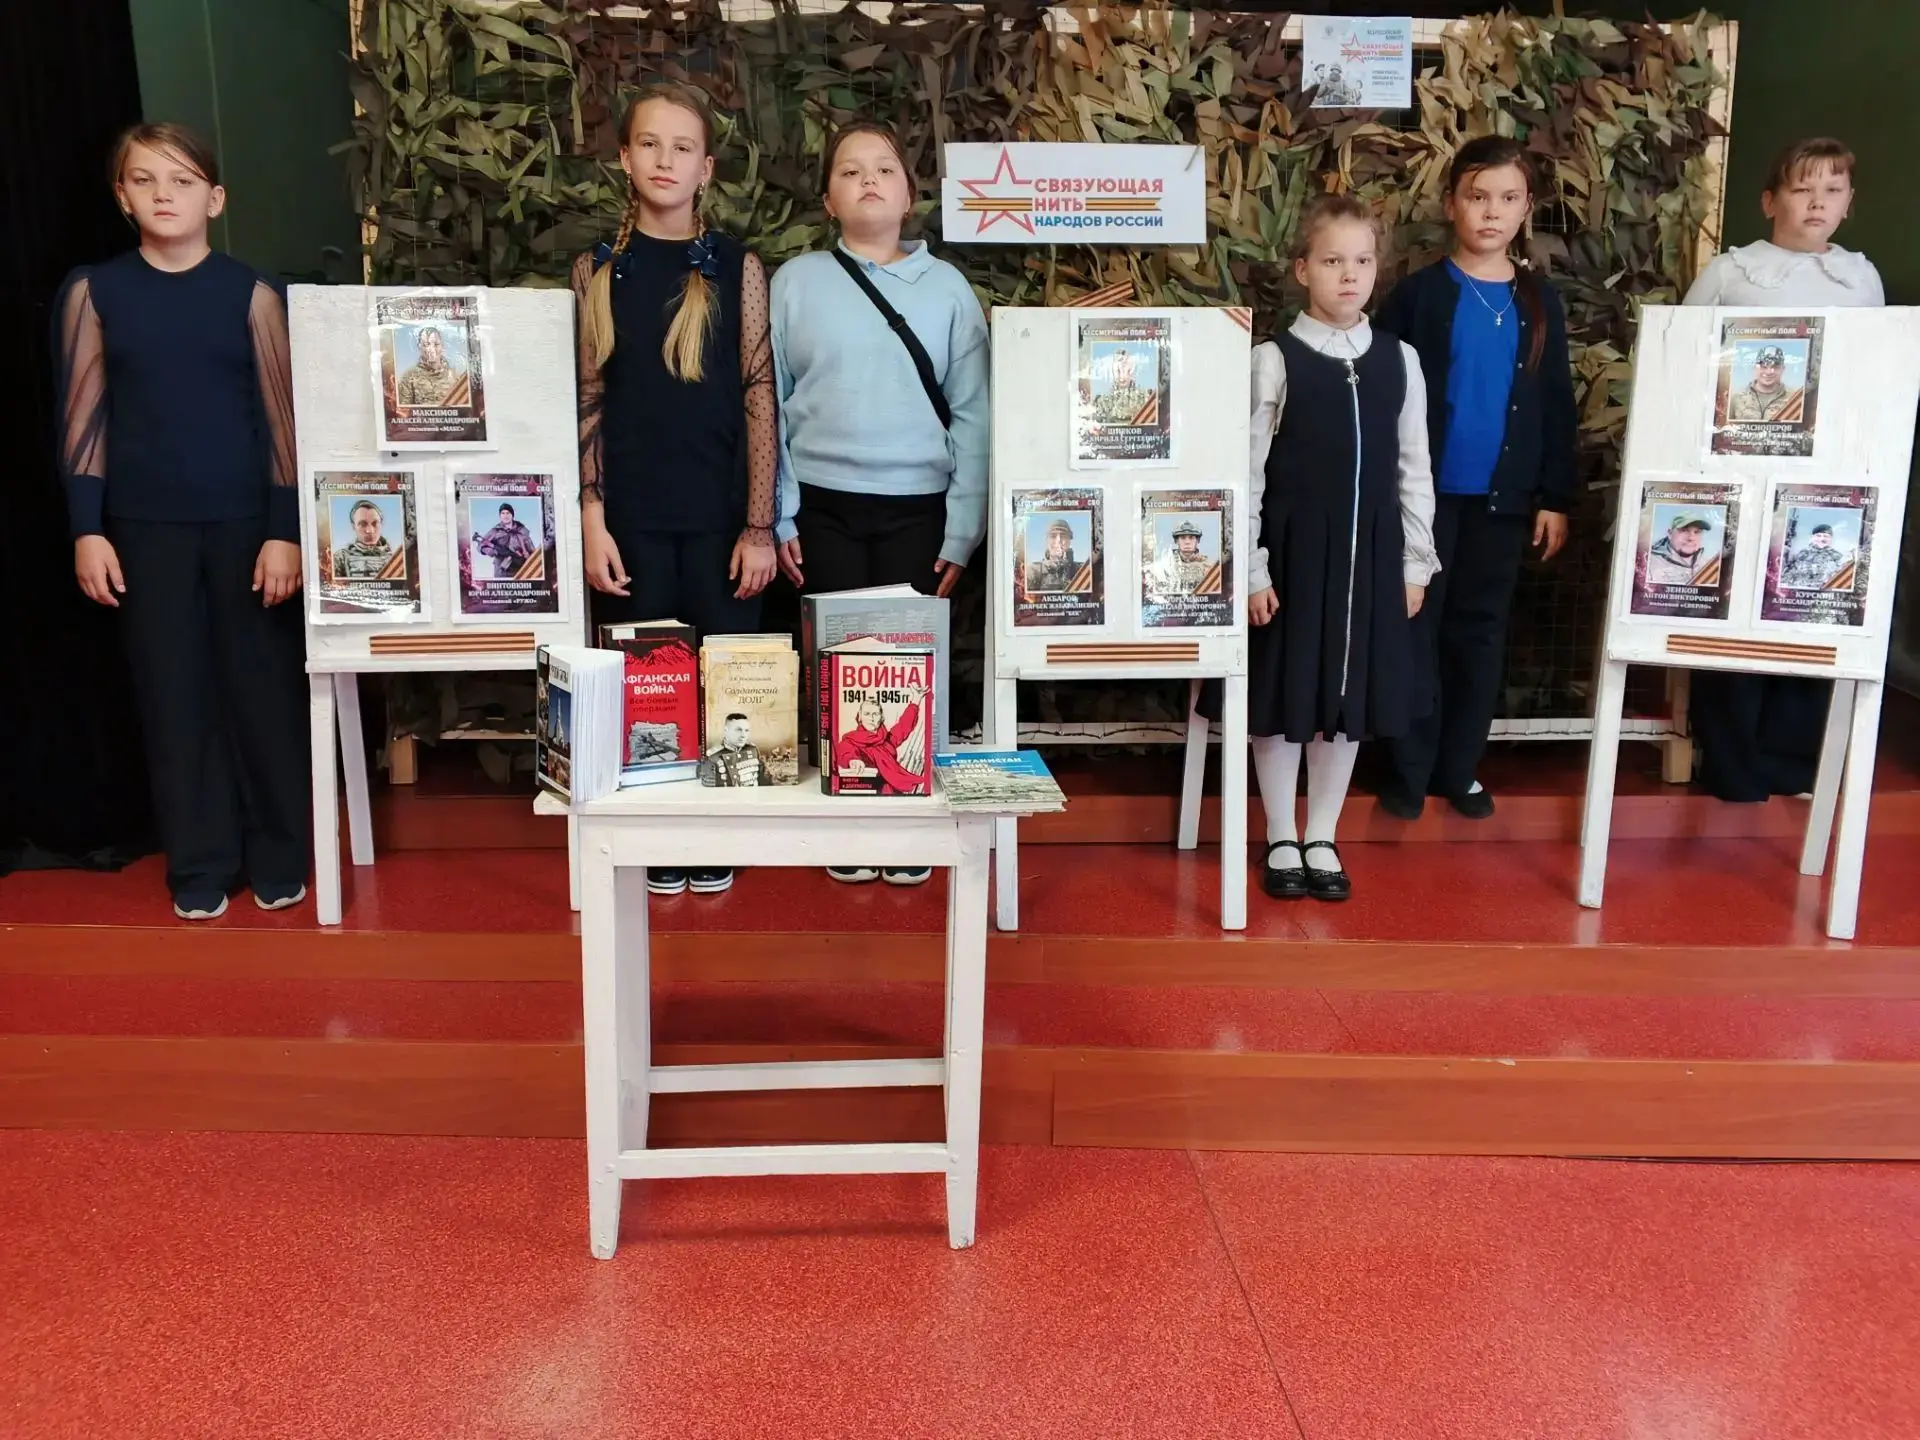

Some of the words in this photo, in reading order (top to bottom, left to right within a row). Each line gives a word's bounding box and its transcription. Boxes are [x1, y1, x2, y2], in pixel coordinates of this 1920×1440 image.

[1035, 178, 1163, 195] СВЯЗУЮЩАЯ
[1035, 197, 1084, 212] НИТЬ
[1035, 215, 1102, 228] НАРОДОВ
[1106, 215, 1163, 227] РОССИИ
[1727, 326, 1777, 334] БЕССМЕРТНЫЙ
[412, 409, 458, 417] МАКСИМОВ
[391, 416, 422, 424] АЛЕКСЕЙ
[1735, 424, 1793, 432] РАСНОПЕРОВ
[320, 482, 369, 490] БЕССМЕРТНЫЙ
[460, 484, 508, 492] БЕССМЕРТНЫЙ
[468, 589, 490, 597] ЮРИЙ
[1669, 594, 1720, 602] ВИКТОРОВИЧ
[820, 659, 830, 688] ВОЙНА
[842, 660, 922, 688] ВОЙНА
[634, 683, 675, 695] ВОЙНА
[724, 687, 778, 696] Солдатский
[738, 696, 765, 705] ДОЛГ
[633, 705, 677, 713] операции
